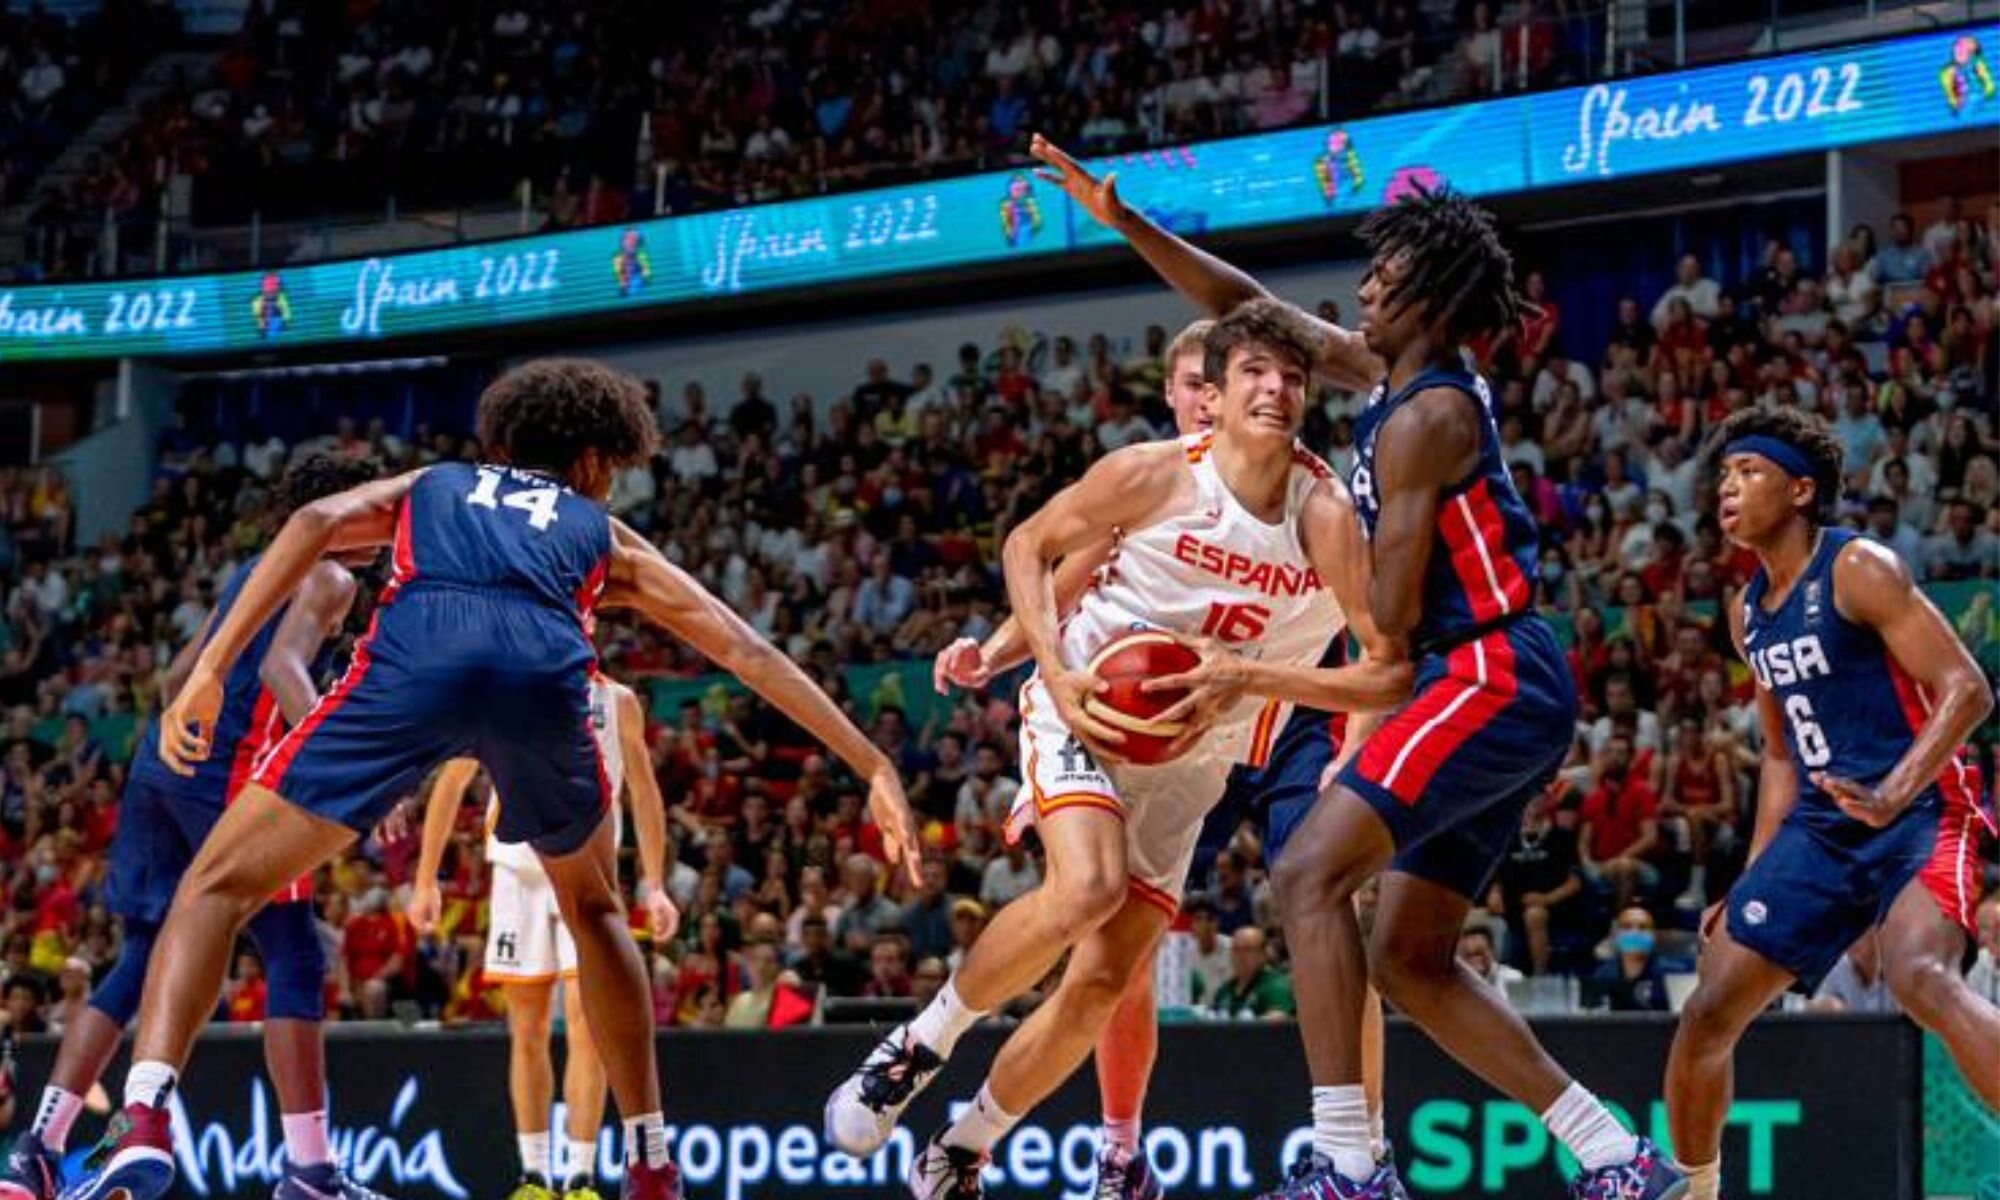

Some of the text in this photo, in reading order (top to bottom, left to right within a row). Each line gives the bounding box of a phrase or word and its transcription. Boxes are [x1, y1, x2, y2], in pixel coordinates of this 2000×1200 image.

[1563, 63, 1863, 174] Spain 2022
[702, 195, 940, 290] Spain 2022
[0, 289, 196, 333] pain 2022
[340, 249, 562, 335] Spain 2022
[467, 467, 559, 531] 14
[1175, 533, 1322, 597] ESPAÑA
[1201, 602, 1269, 642] 16
[1750, 634, 1831, 691] USA
[1785, 694, 1831, 767] 6
